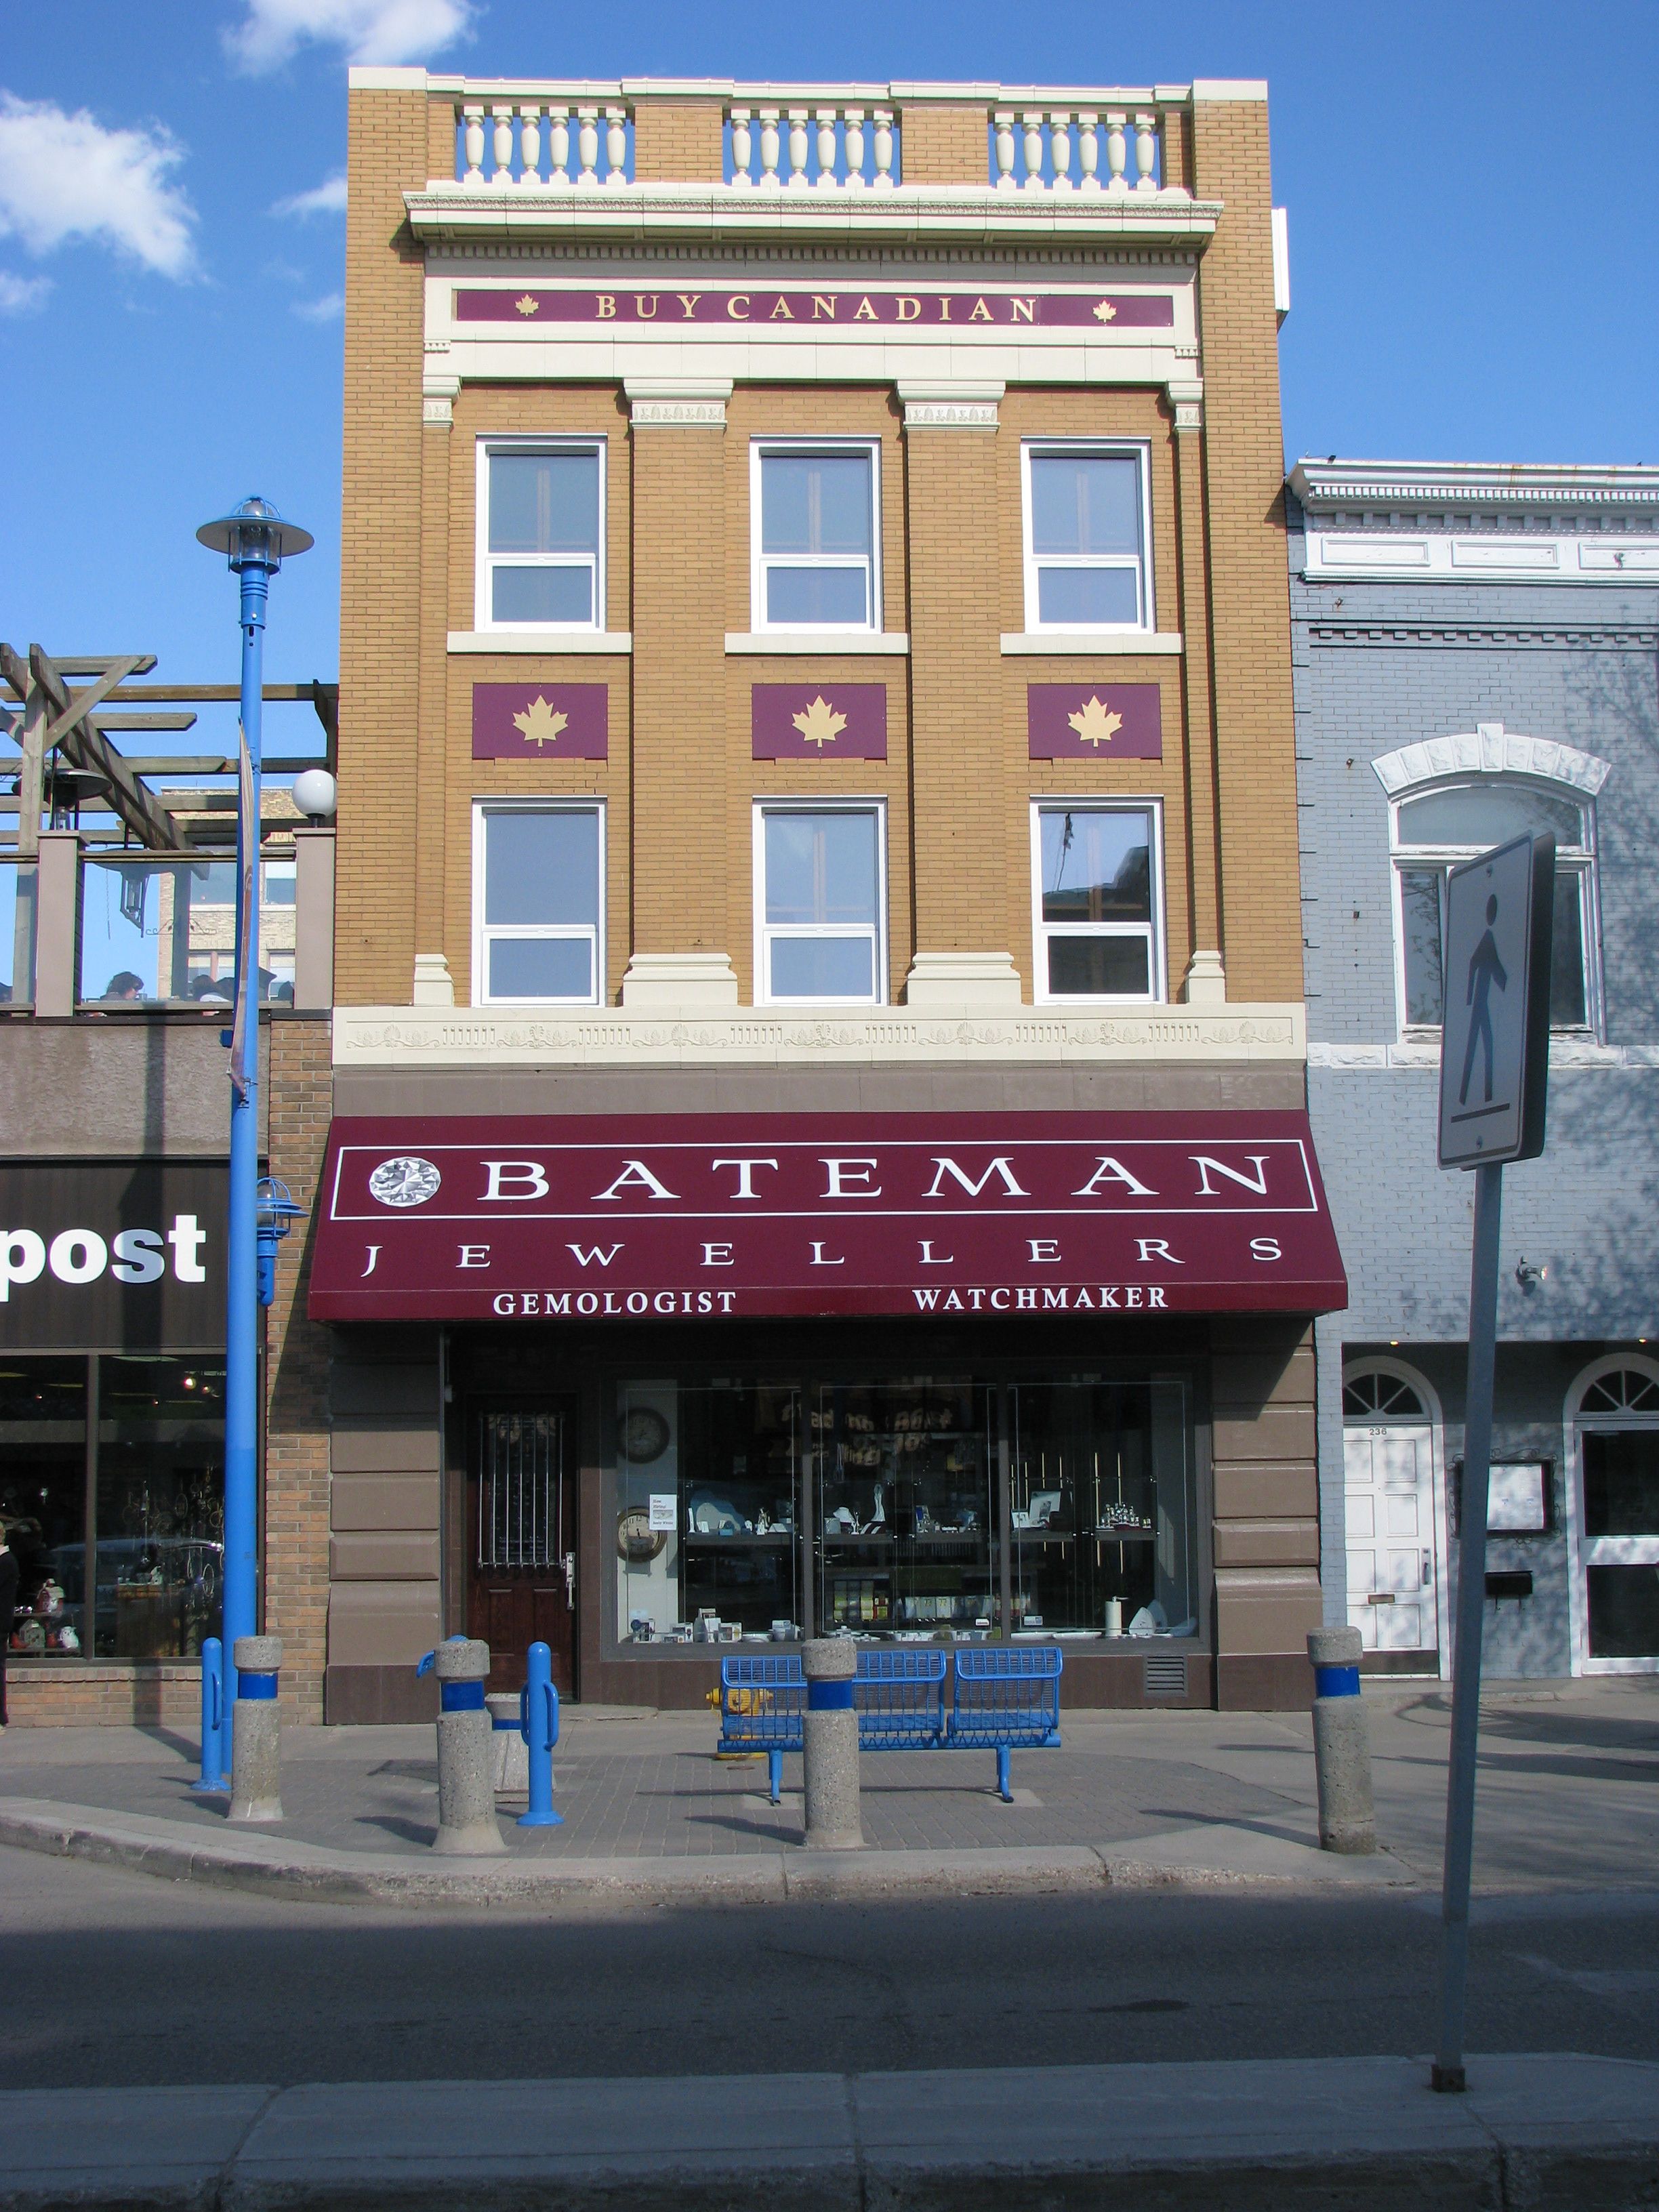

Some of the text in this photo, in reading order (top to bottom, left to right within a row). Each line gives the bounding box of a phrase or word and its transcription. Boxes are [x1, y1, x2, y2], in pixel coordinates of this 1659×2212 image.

[595, 293, 1037, 323] BUY CANADIAN
[476, 1156, 1271, 1202] BATEMAN
[0, 1214, 207, 1303] post
[361, 1237, 1282, 1277] JEWELLERS
[493, 1286, 1169, 1316] GEMOLOGIST WATCHMAKER
[1369, 1427, 1387, 1435] 236
